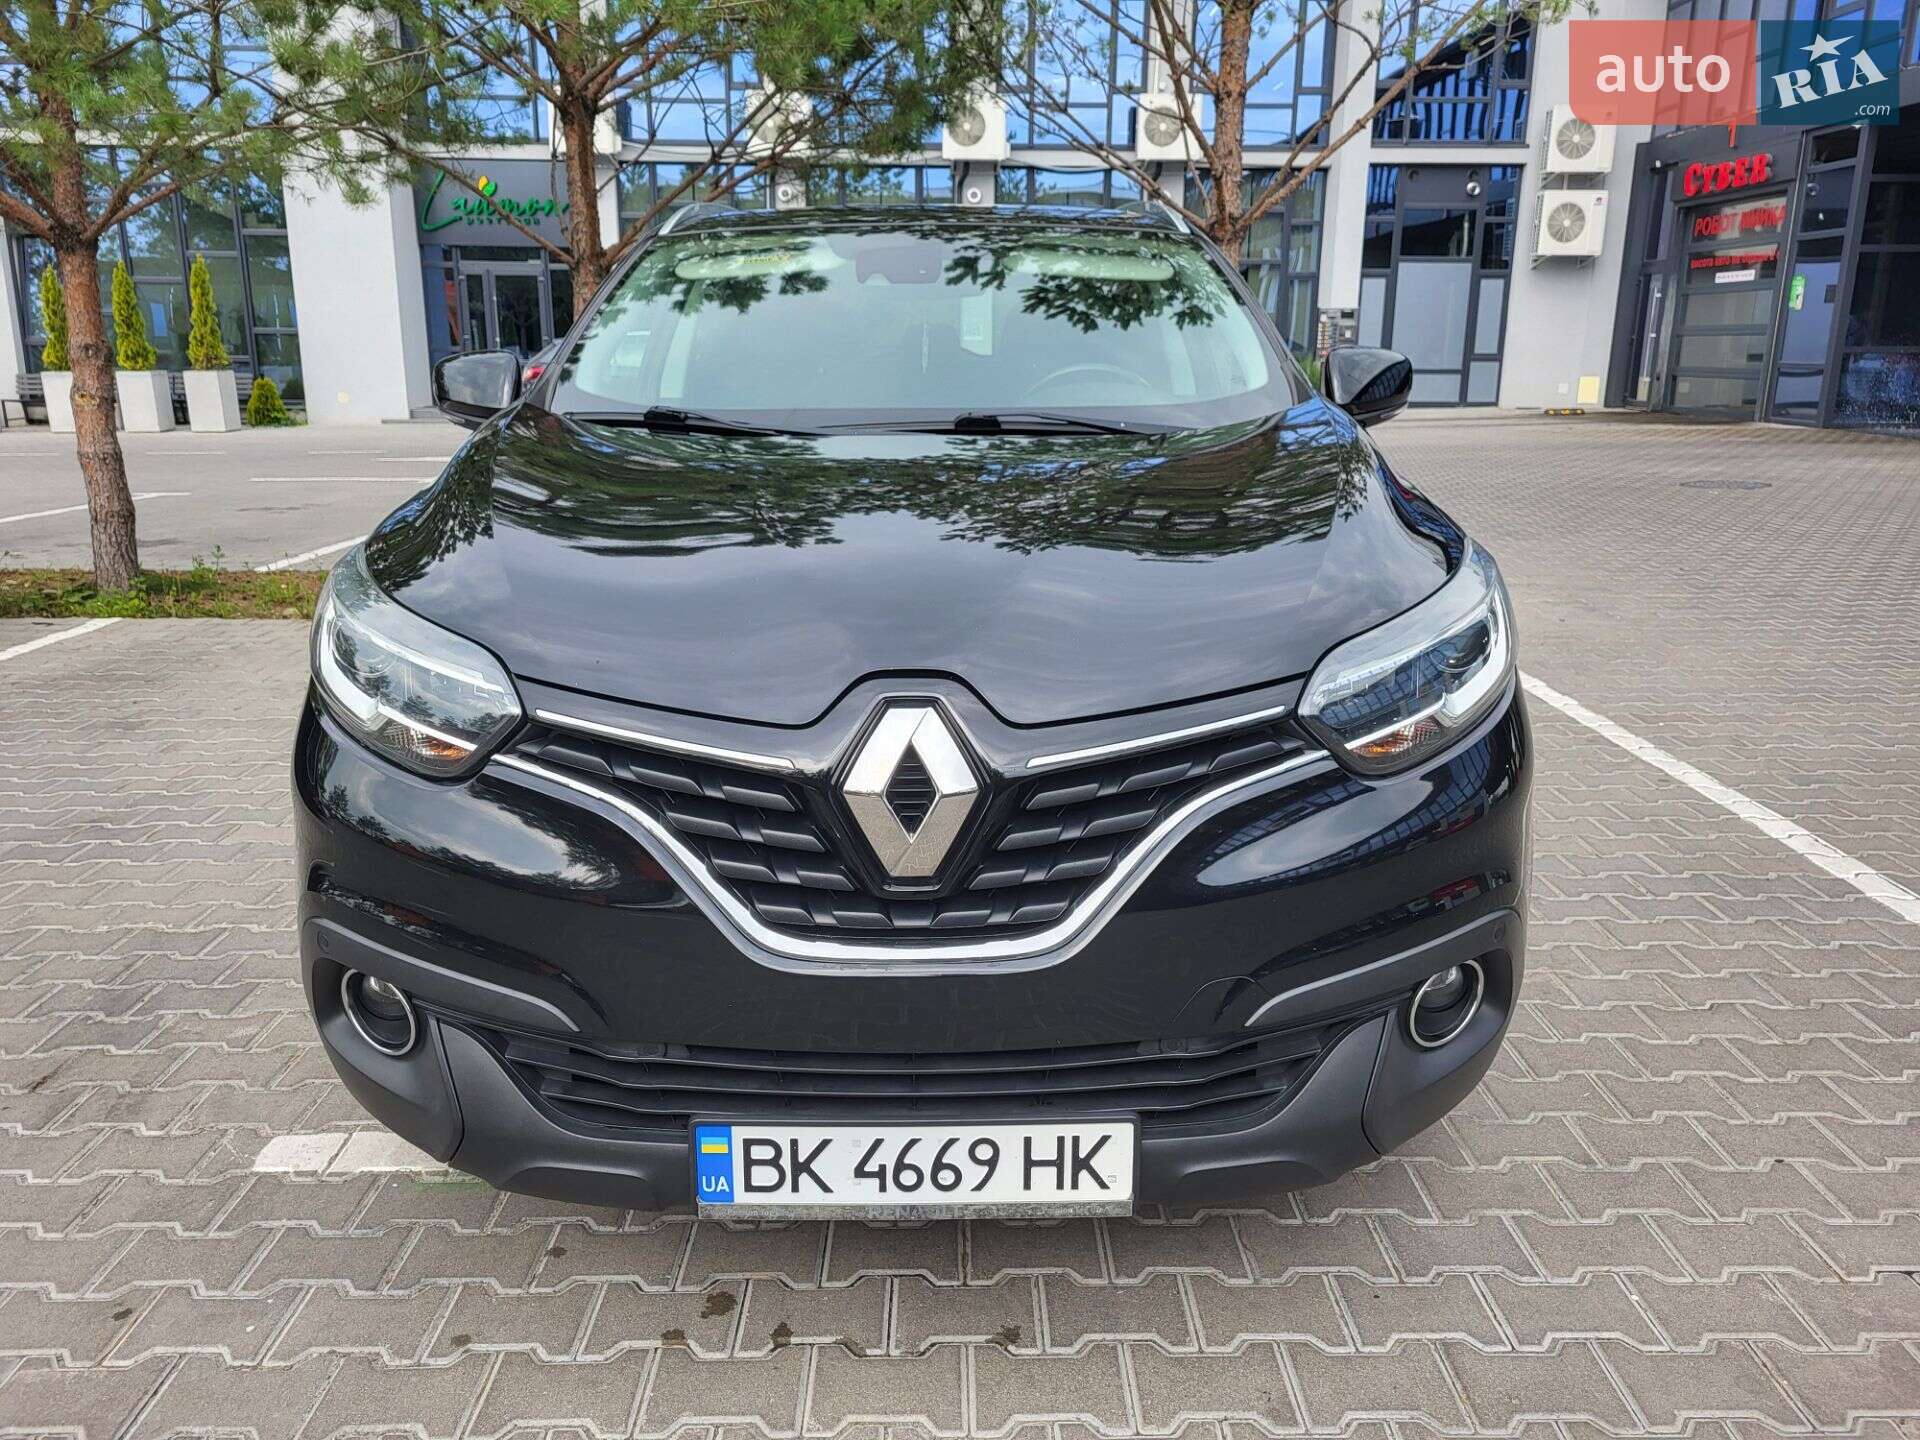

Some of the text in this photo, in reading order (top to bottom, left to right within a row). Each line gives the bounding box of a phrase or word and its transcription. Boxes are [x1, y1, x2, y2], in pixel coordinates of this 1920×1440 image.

[742, 1134, 1113, 1193] BK 4669 HK
[702, 1175, 730, 1193] UA
